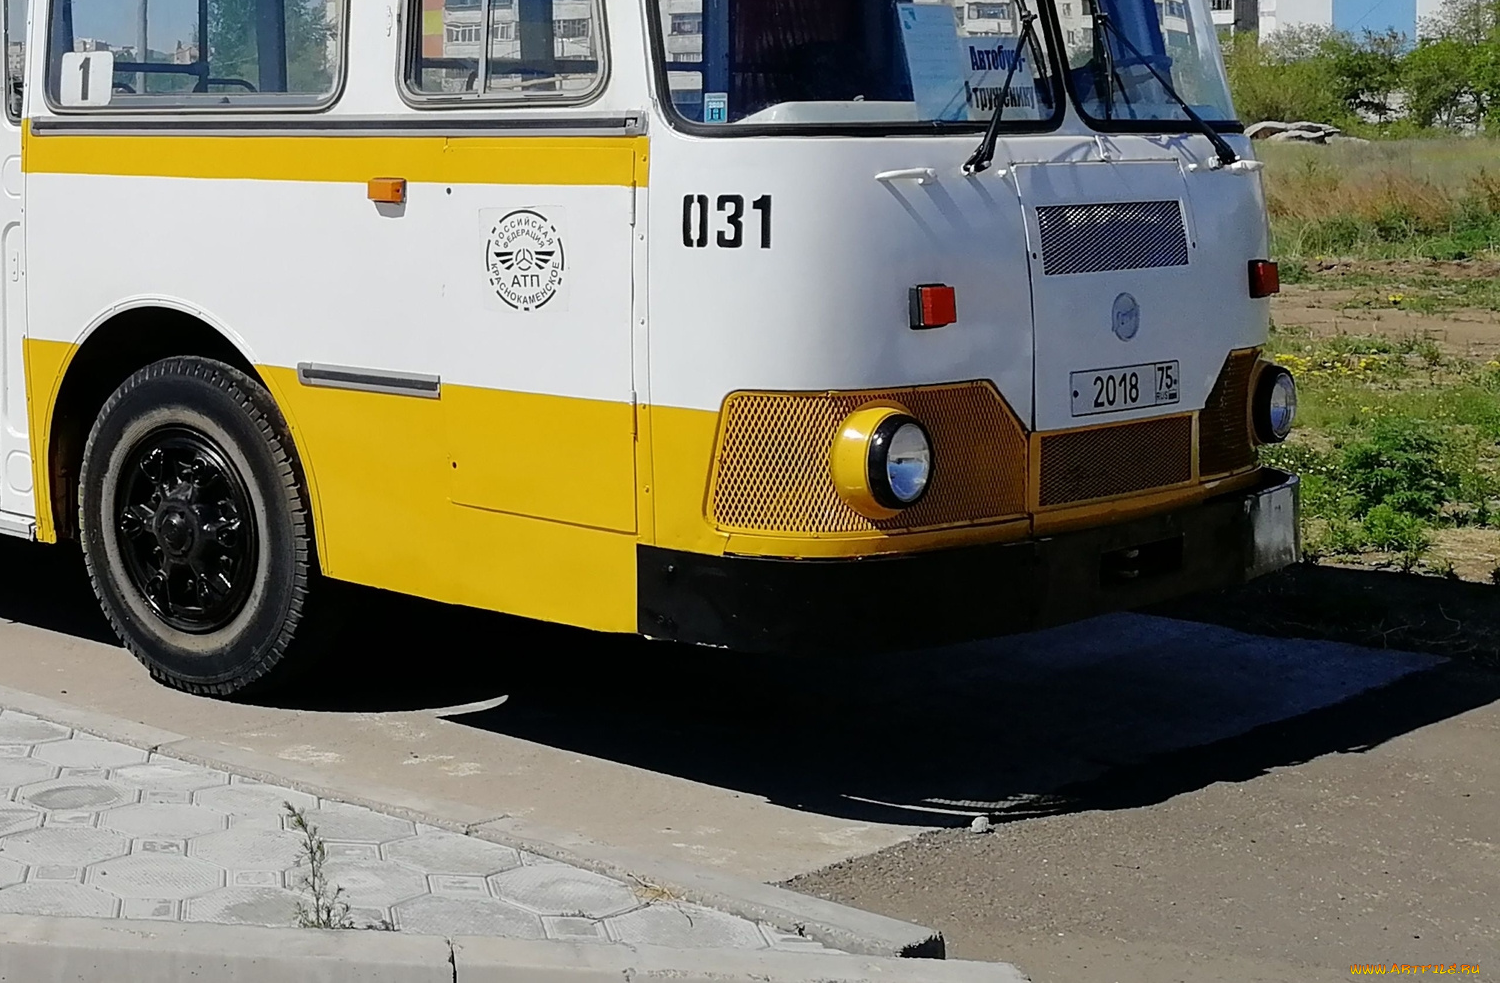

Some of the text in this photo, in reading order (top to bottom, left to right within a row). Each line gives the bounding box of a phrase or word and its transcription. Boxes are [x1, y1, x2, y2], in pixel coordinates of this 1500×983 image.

[79, 56, 91, 101] 1
[494, 217, 554, 247] РОССИЙСКАЯ
[503, 229, 545, 249] ФЕДЕРАЦИЯ
[682, 194, 772, 249] 031
[491, 261, 560, 305] КРАСНОКАМЕНСКОЕ
[511, 274, 540, 288] АТП
[1093, 365, 1173, 408] 2018 75
